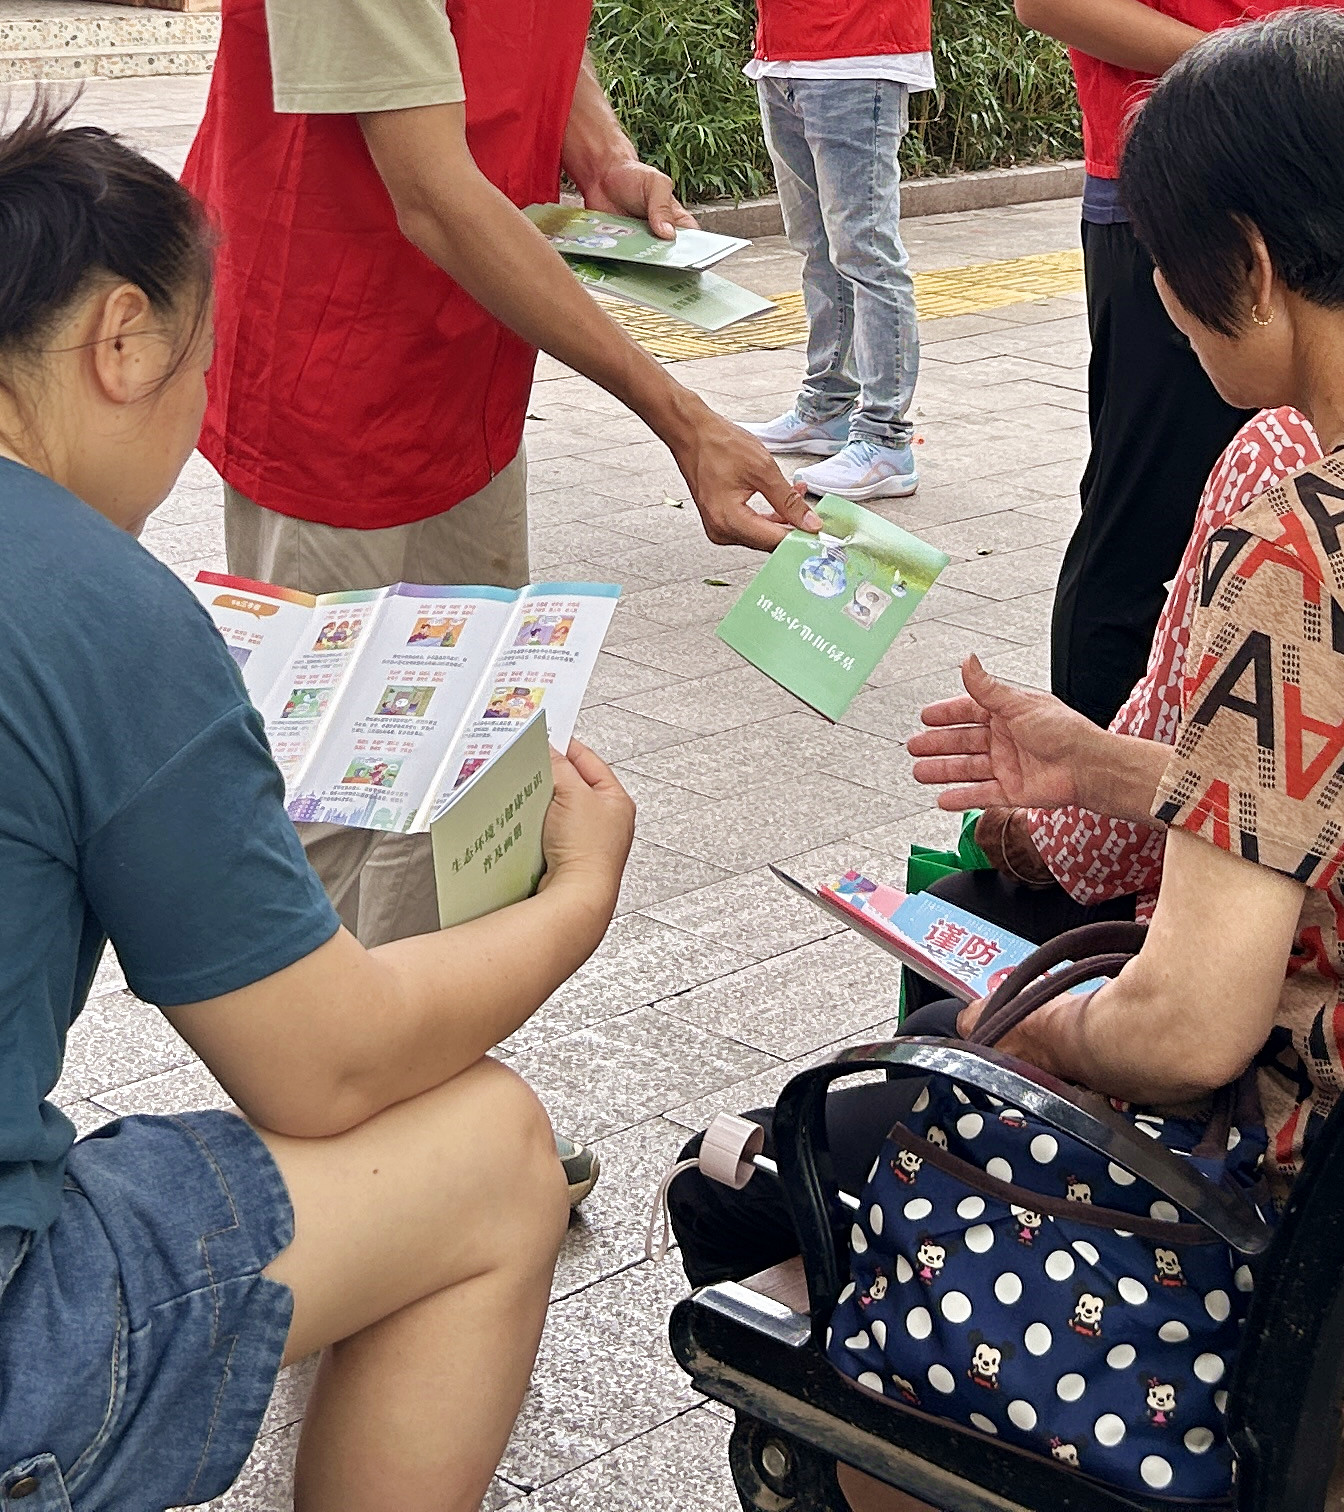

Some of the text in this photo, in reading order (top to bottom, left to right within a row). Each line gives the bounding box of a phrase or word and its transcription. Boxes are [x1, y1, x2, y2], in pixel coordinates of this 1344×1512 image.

[756, 593, 856, 672] 节约用电小常识
[923, 918, 1002, 966] 谨防
